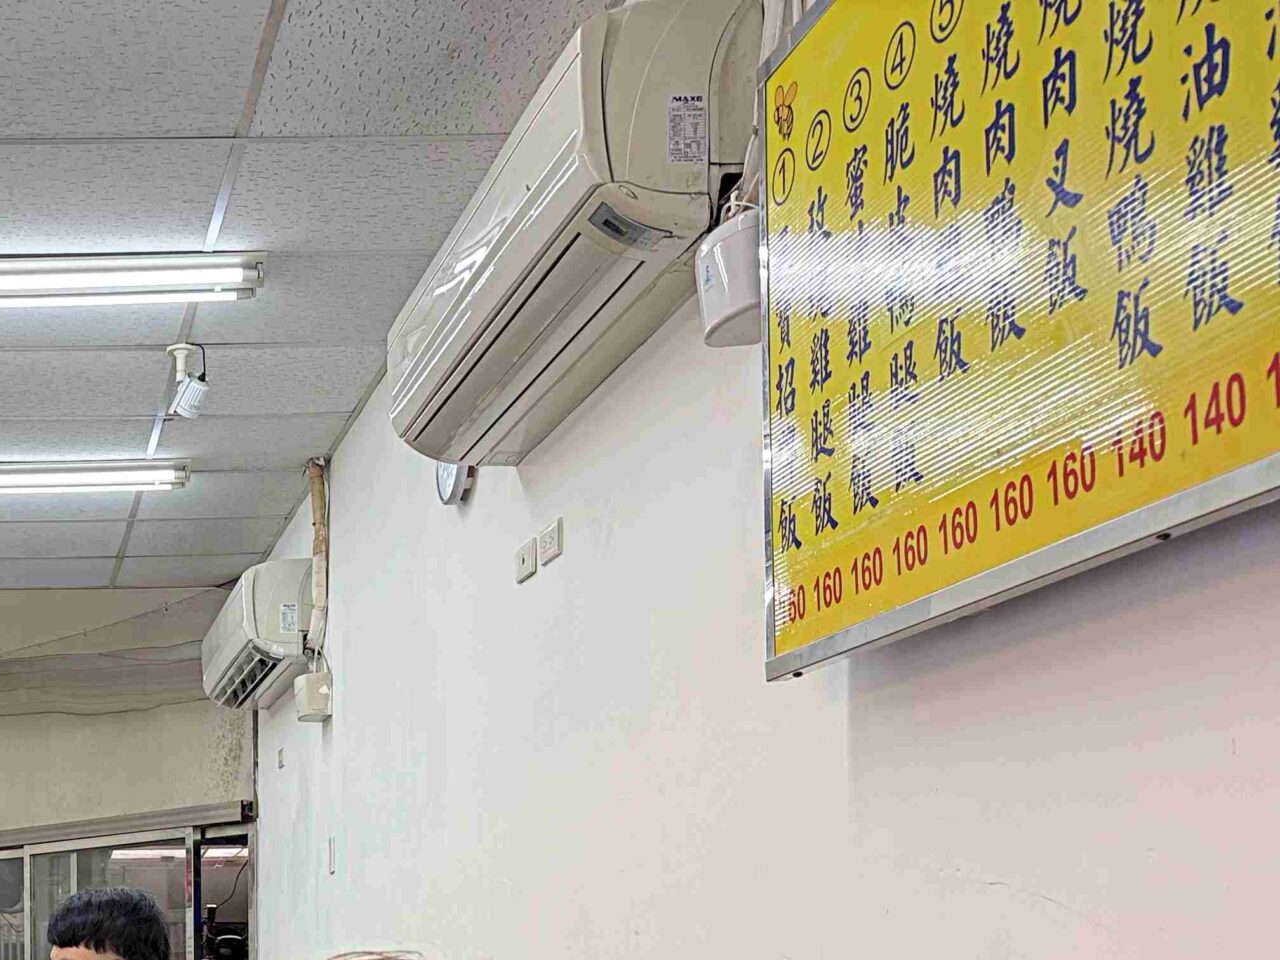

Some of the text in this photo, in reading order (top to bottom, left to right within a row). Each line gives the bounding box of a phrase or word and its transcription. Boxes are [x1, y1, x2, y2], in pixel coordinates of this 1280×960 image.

[845, 144, 879, 516] 蜜雞腿飯
[930, 53, 970, 383] 燒肉飯
[1176, 0, 1244, 332] 油雞飯
[808, 185, 838, 536] 玫雞腿飯
[813, 567, 842, 613] 160
[851, 546, 883, 595] 160
[892, 524, 928, 576] 160
[939, 500, 978, 555] 160
[989, 473, 1034, 532] 160
[1047, 443, 1096, 506] 160
[1112, 410, 1166, 478] 140
[1184, 372, 1247, 446] 140
